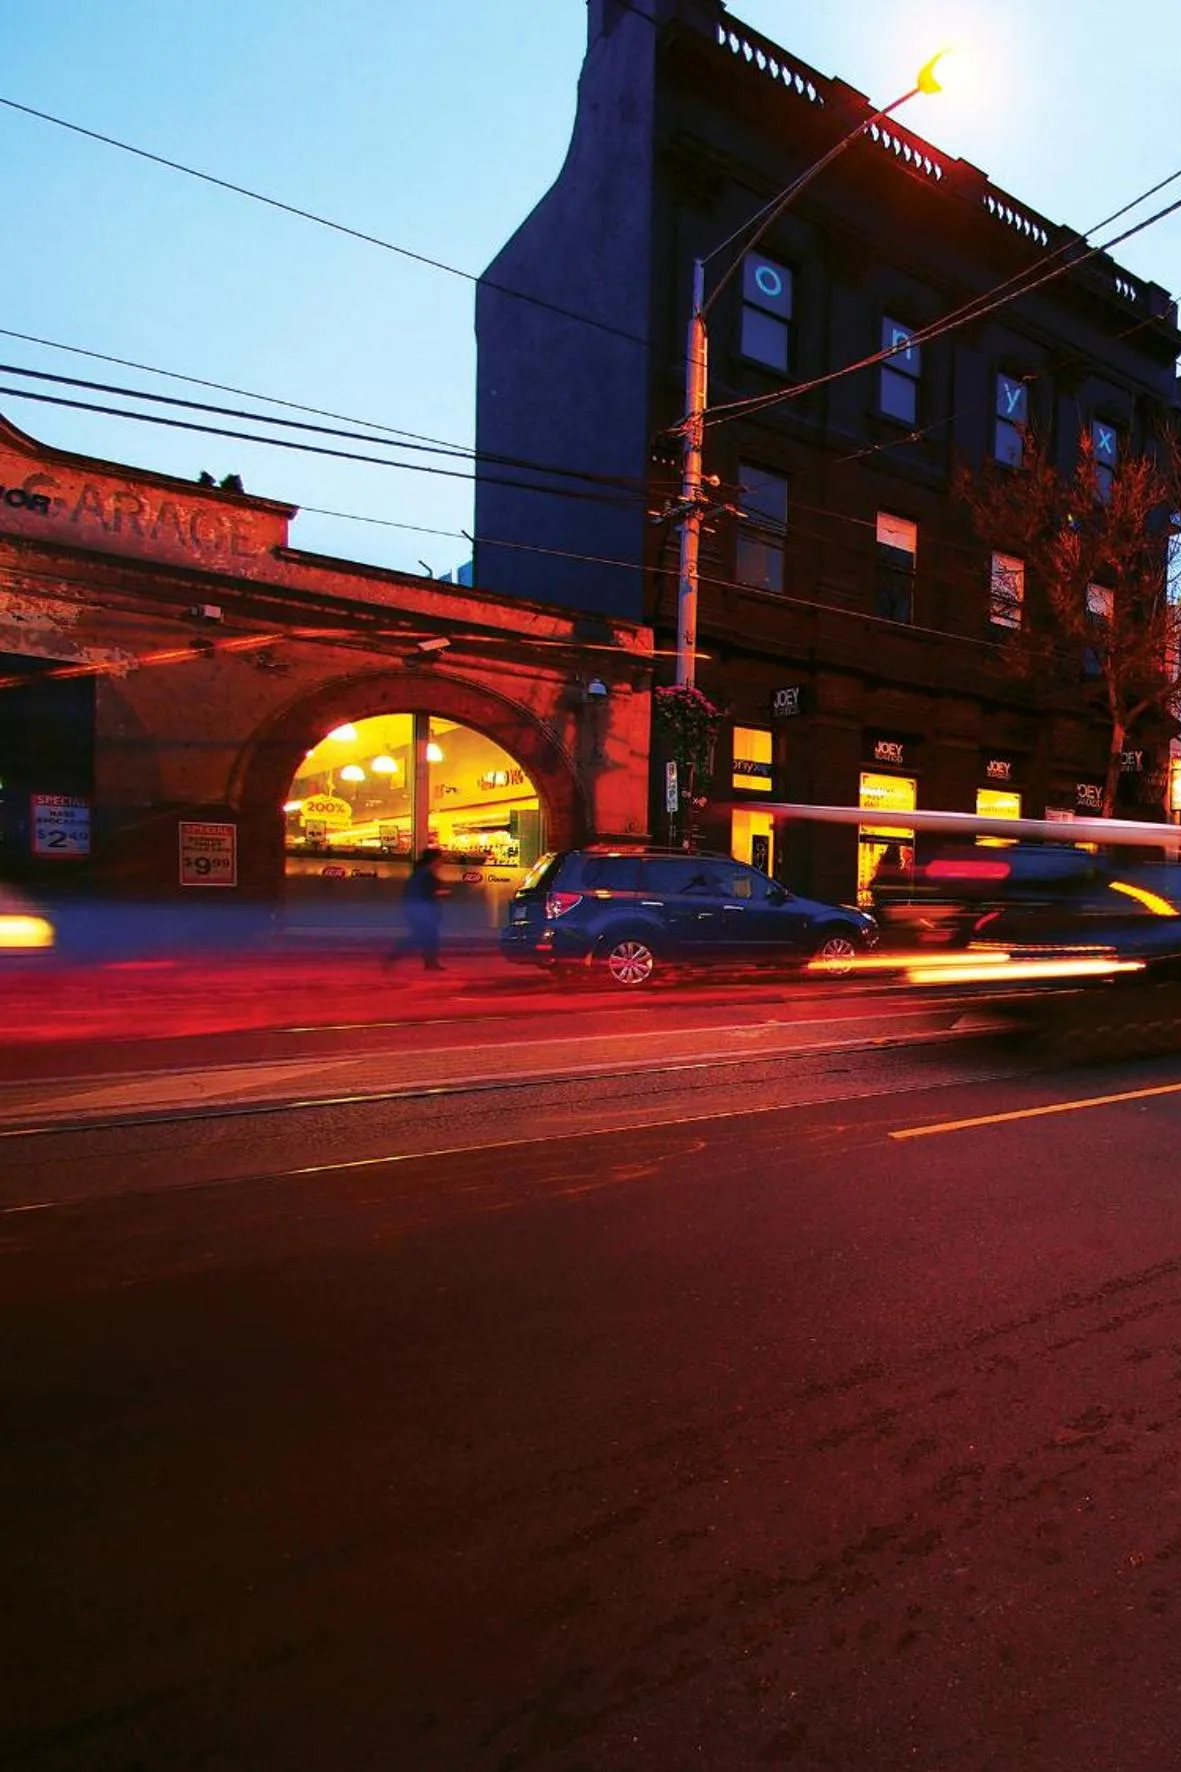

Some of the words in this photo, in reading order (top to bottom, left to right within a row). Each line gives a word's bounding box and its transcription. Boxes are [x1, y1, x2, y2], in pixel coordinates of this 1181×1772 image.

[773, 687, 800, 709] JOEY
[874, 741, 903, 756] JOEY
[1120, 751, 1143, 766] OEY
[986, 760, 1011, 774] JOEY
[306, 802, 346, 814] 200%
